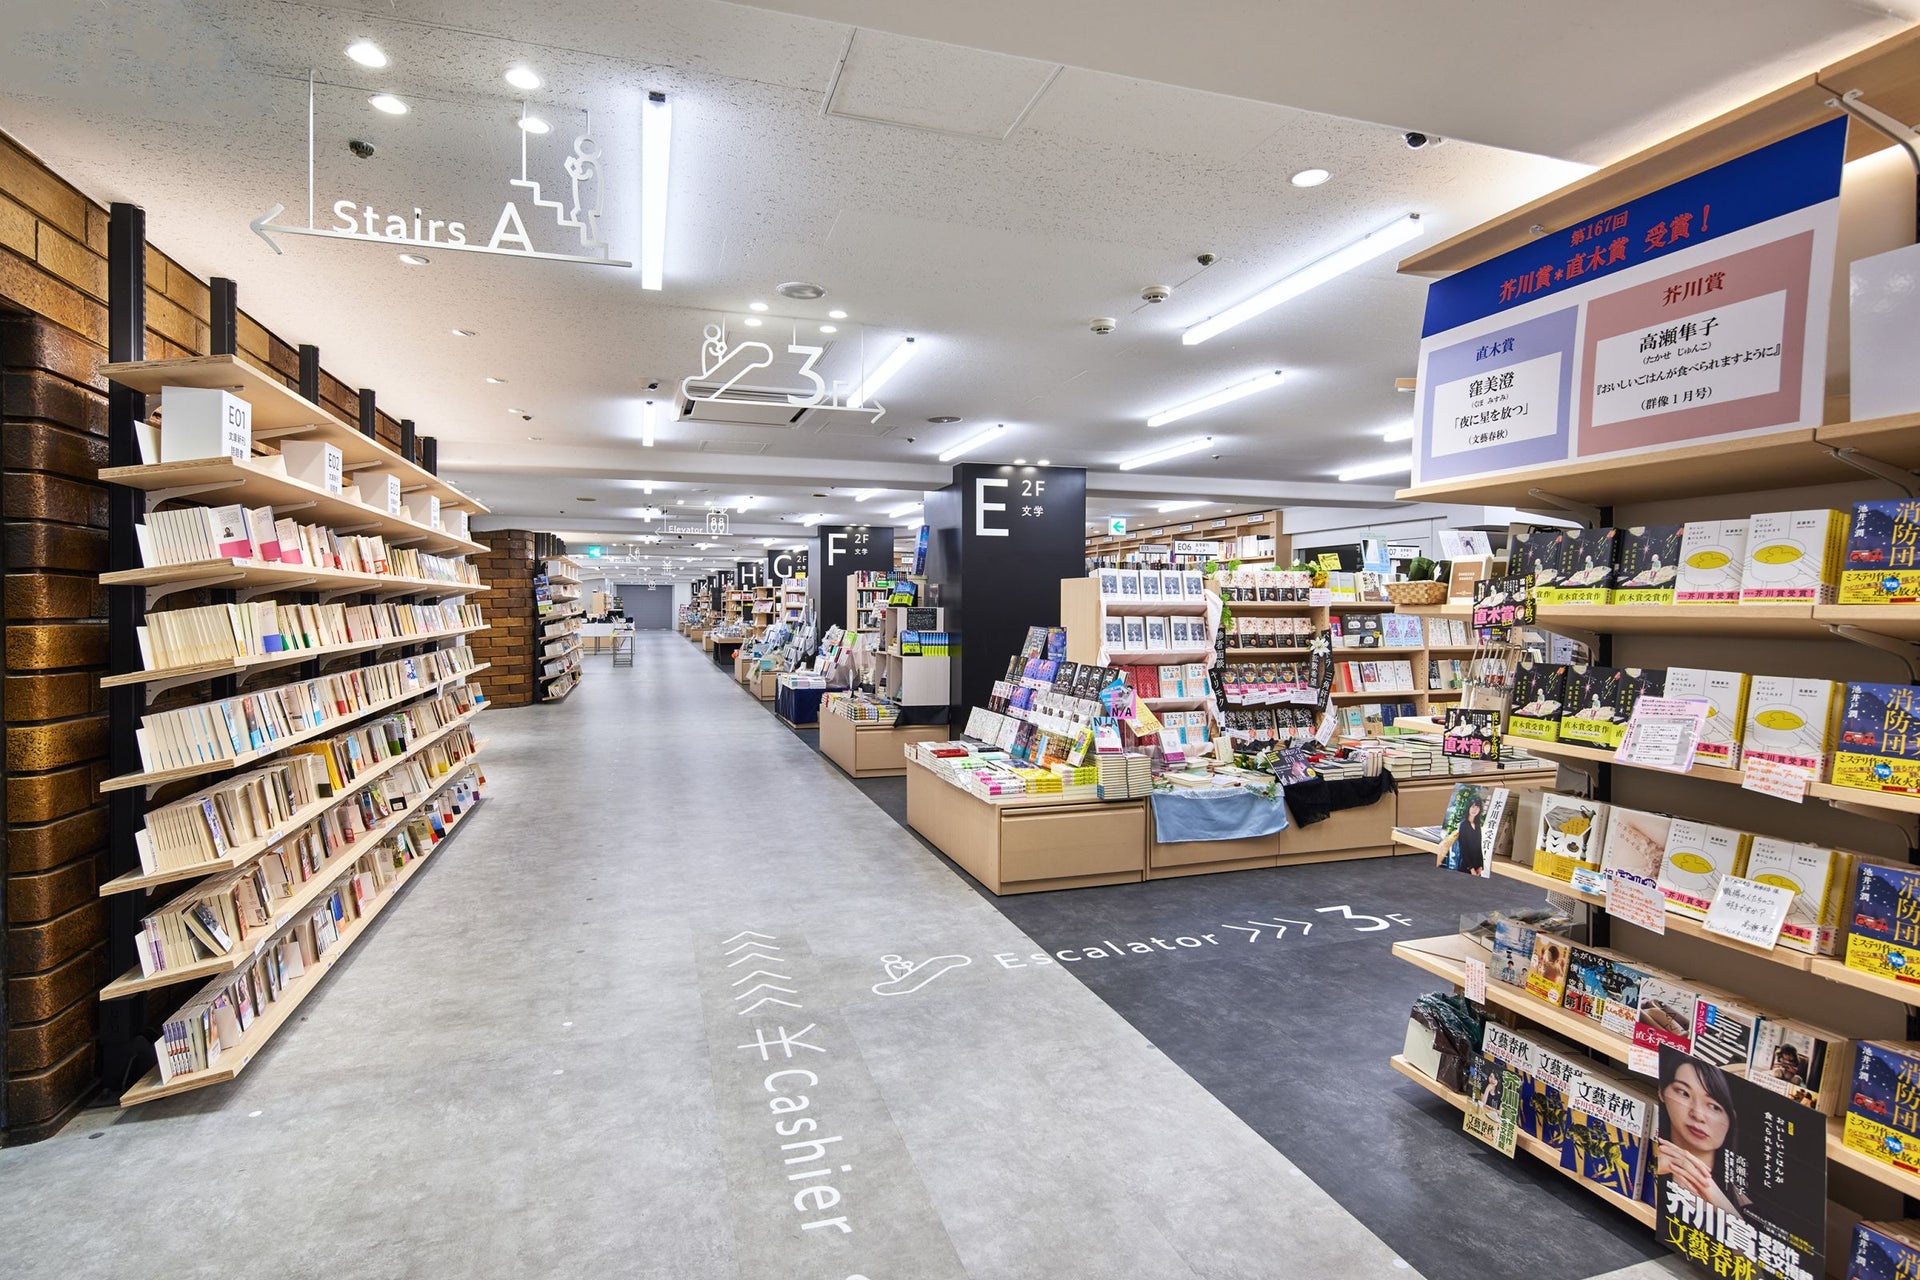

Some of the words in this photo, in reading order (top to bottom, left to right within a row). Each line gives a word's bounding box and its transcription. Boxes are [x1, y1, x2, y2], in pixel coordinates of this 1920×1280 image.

[333, 200, 467, 248] Stairs
[487, 202, 535, 254] A
[1570, 210, 1628, 247] 第167回
[1662, 271, 1726, 307] 芥川賞
[1476, 337, 1515, 362] 直木賞
[1640, 317, 1719, 353] 高瀬隼子
[1469, 371, 1515, 398] 窪美澄
[1597, 343, 1781, 396] 『おいしいごはんが食べられますように』
[229, 405, 246, 429] E01
[1454, 402, 1529, 429] 「夜に星を放つ」
[976, 478, 1009, 536] E
[1022, 480, 1045, 496] 2F
[1022, 506, 1044, 517] 文学
[1854, 504, 1868, 538] 池井戸潤
[668, 526, 703, 534] Elevator
[1177, 543, 1192, 551] E06
[1889, 501, 1920, 567] 消防団
[773, 554, 792, 578] G
[796, 555, 807, 563] 2F
[828, 533, 847, 566] F
[854, 533, 869, 545] 2F
[742, 566, 756, 584] H
[1556, 591, 1601, 602] 直木賞受賞作
[1618, 592, 1670, 602] 直木賞受賞作
[1474, 605, 1515, 625] 直木賞
[1112, 705, 1132, 717] N/A
[1848, 685, 1862, 719] 池井戸潤
[1512, 720, 1551, 732] 直木賞受賞作
[1563, 721, 1610, 733] 直木賞受賞作
[1881, 687, 1913, 755] 消防団
[1444, 737, 1482, 753] 直木賞
[1859, 867, 1873, 902] 池井戸潤
[993, 930, 1220, 971] Escalator
[1572, 949, 1613, 968] ふがいない
[1489, 1028, 1530, 1061] 文藝春秋
[1859, 1046, 1873, 1082] 池井戸潤
[1501, 1070, 1521, 1125] 芥川賞
[1577, 1081, 1635, 1121] 文藝春秋
[1467, 1114, 1495, 1136] 文藝春秋
[764, 1068, 853, 1237] Cashier
[1764, 1111, 1773, 1189] 食べられますように
[1775, 1117, 1785, 1184] おいしいごはんが
[1666, 1181, 1758, 1263] 芥川賞
[1665, 1215, 1757, 1280] 文藝春秋
[1758, 1231, 1800, 1265] 受賞作
[1856, 1230, 1870, 1267] 池井戸潤
